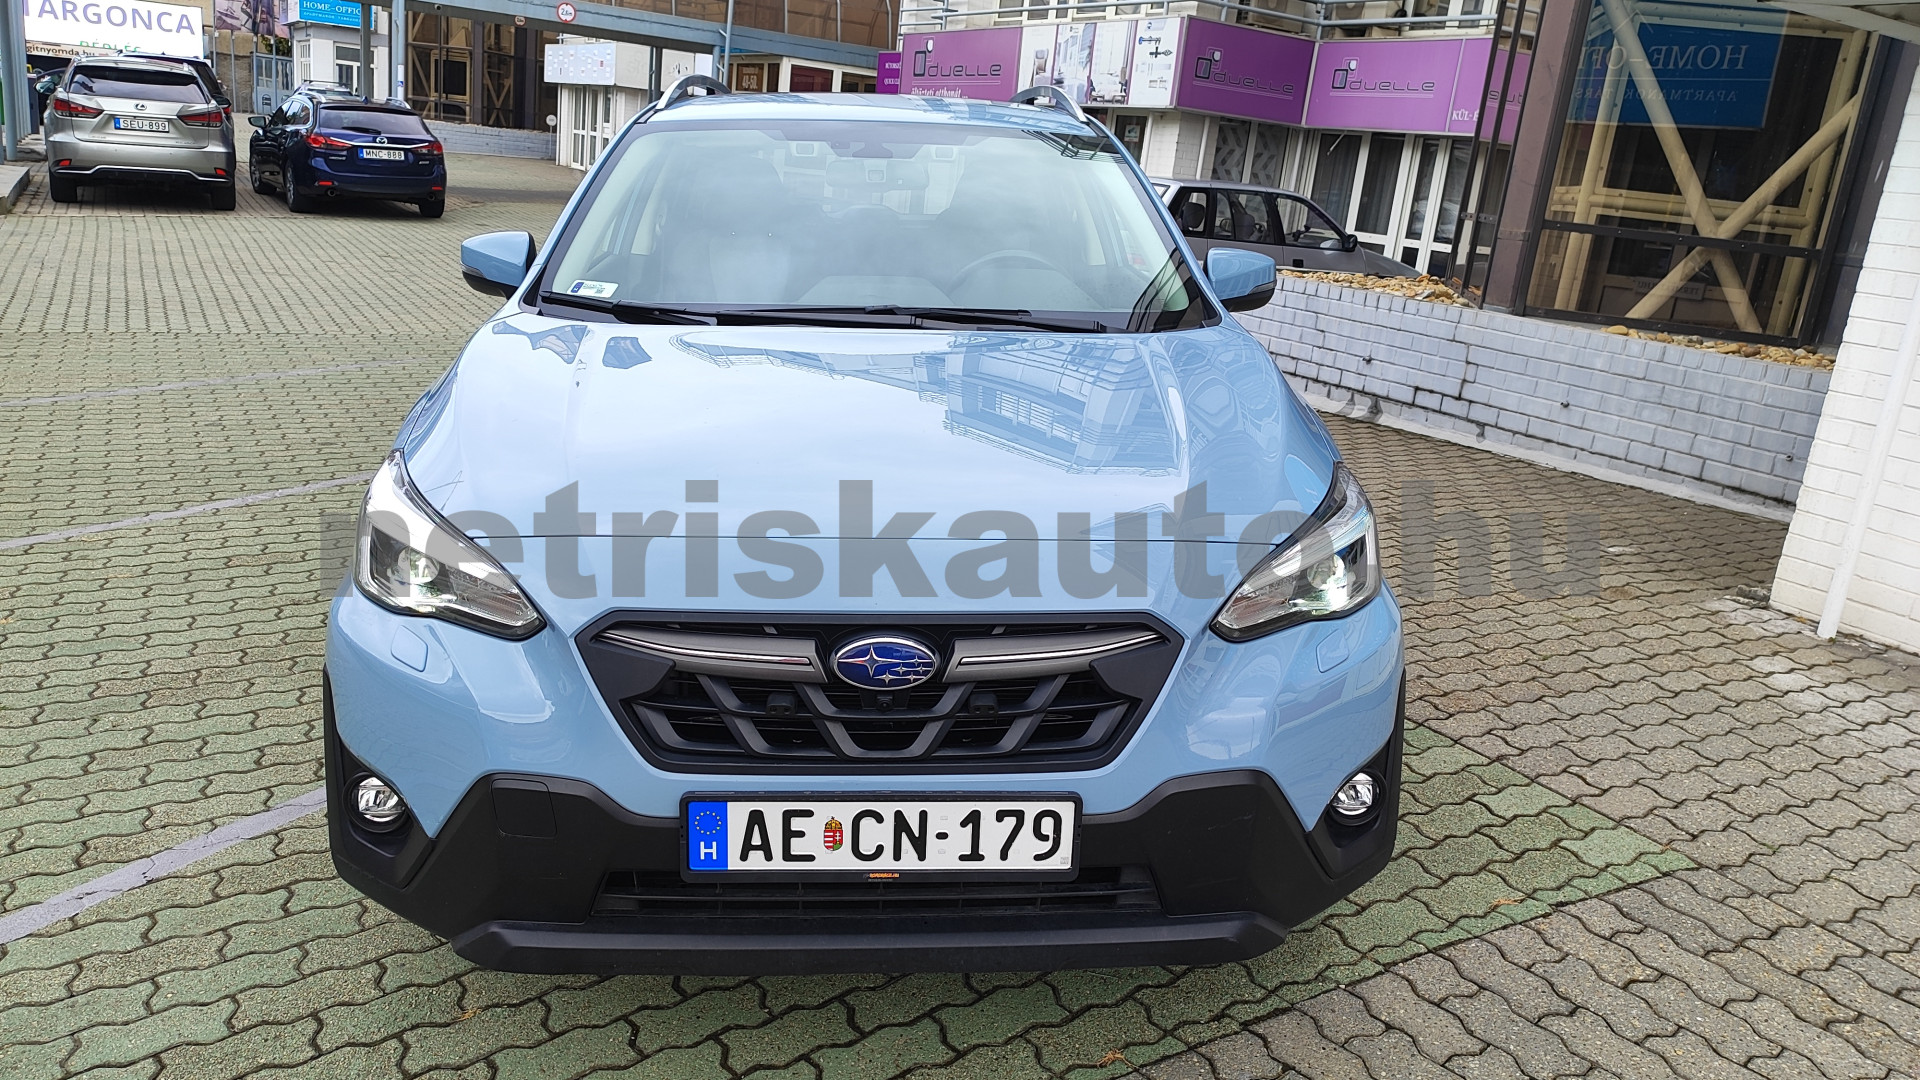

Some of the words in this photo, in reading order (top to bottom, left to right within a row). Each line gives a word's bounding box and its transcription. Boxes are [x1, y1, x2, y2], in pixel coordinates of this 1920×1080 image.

[1214, 71, 1294, 94] duelle
[1349, 79, 1435, 92] duelle
[122, 119, 167, 131] SEU-899
[365, 149, 403, 160] MNC-888
[700, 841, 717, 860] H
